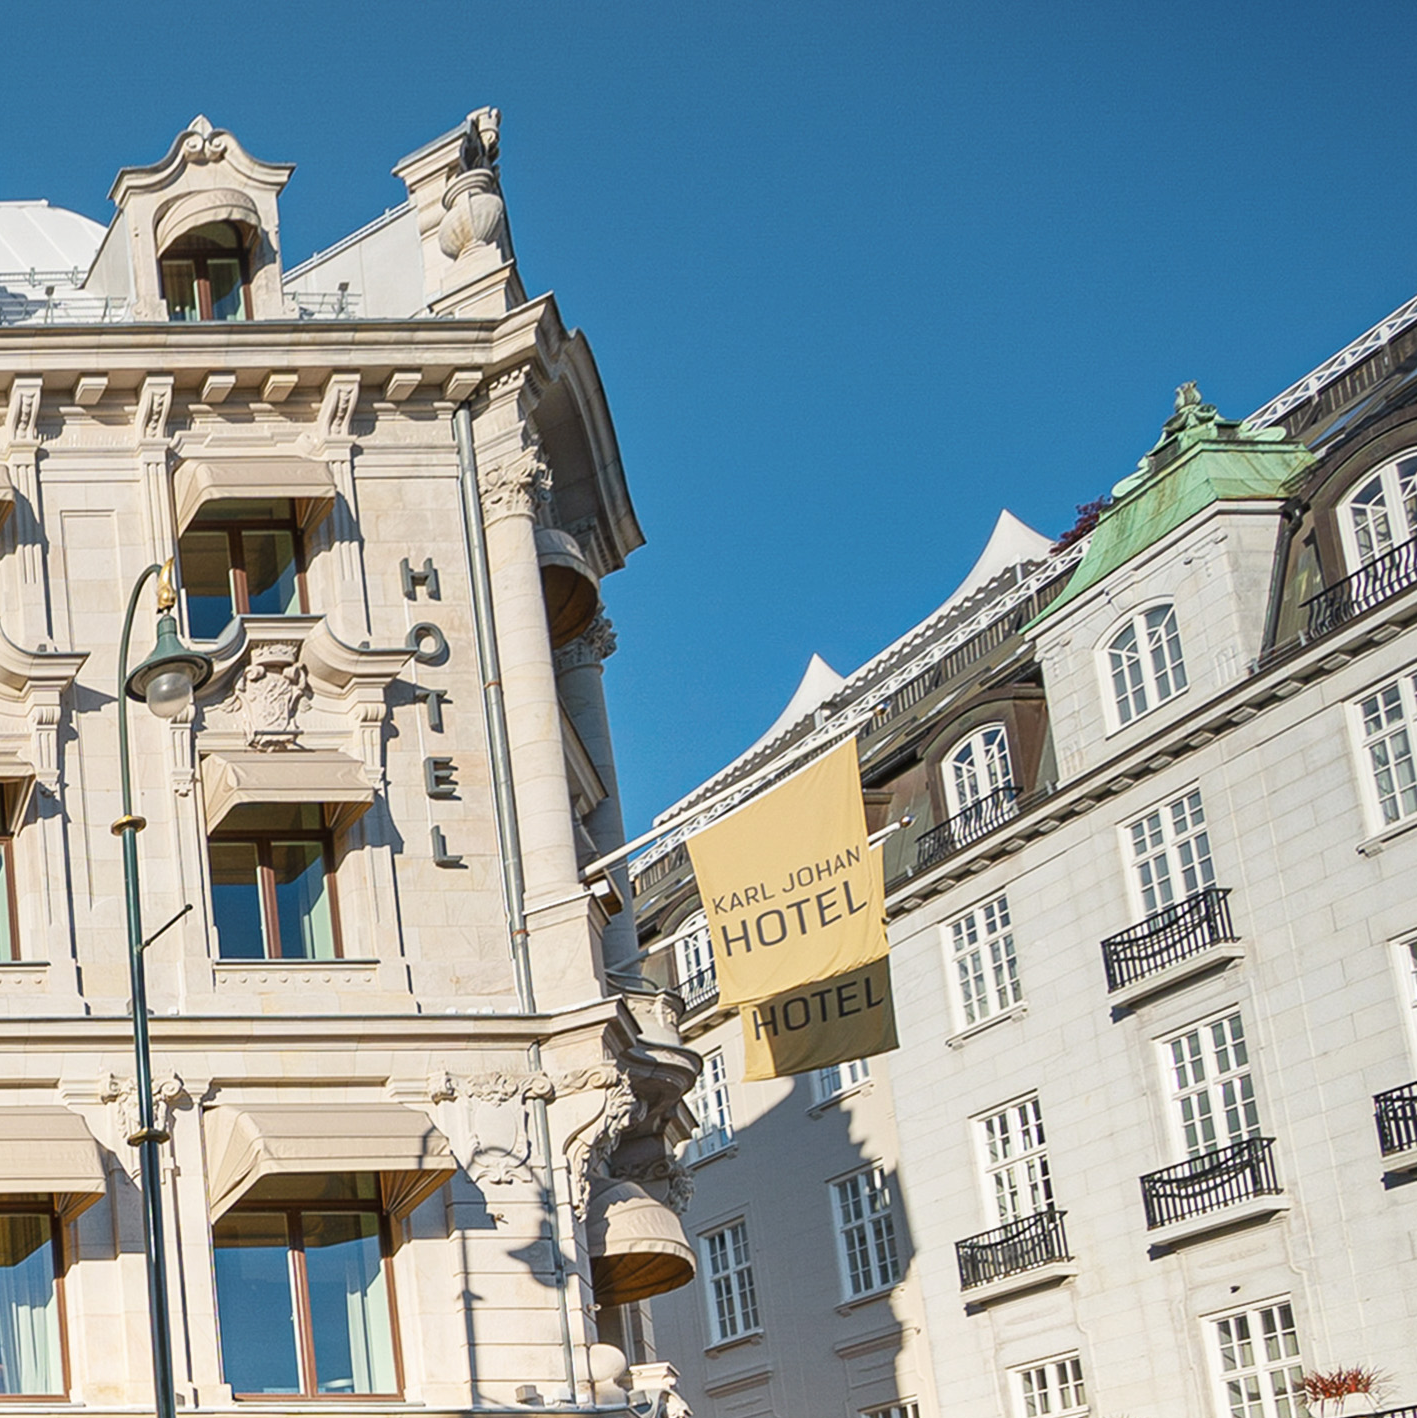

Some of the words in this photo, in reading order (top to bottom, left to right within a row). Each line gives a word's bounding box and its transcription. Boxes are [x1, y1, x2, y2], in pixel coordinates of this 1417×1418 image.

[400, 557, 465, 868] HOTEL
[712, 883, 775, 914] KARL
[782, 845, 861, 893] JOHAN
[721, 880, 867, 957] HOTEL
[752, 977, 884, 1041] HOTEL
